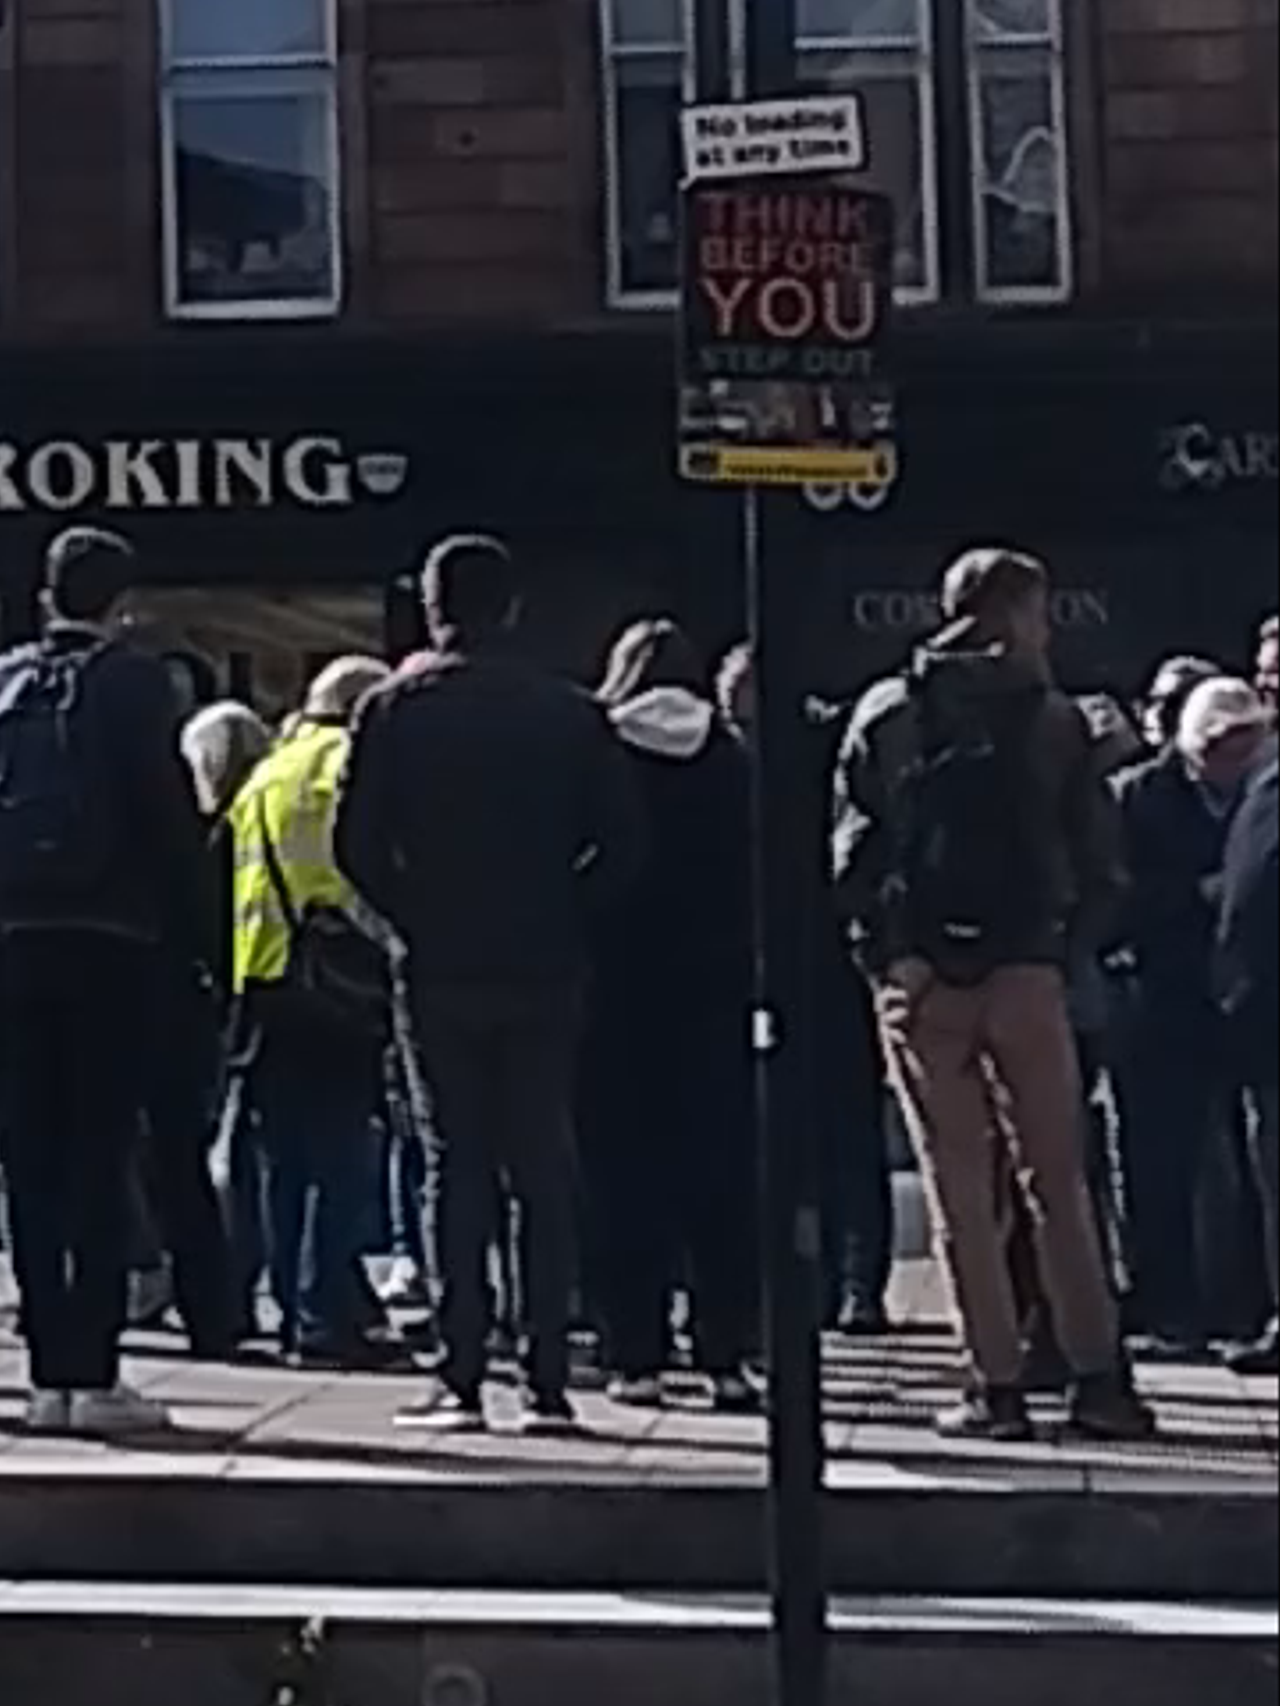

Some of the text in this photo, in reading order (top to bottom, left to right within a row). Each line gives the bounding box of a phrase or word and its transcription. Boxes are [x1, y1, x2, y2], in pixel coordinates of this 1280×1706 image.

[696, 108, 847, 138] No loading
[696, 138, 849, 167] at any time
[697, 193, 868, 236] THINK
[698, 235, 875, 274] BEFORE
[697, 276, 876, 341] YOU
[698, 344, 874, 375] STEP OUT
